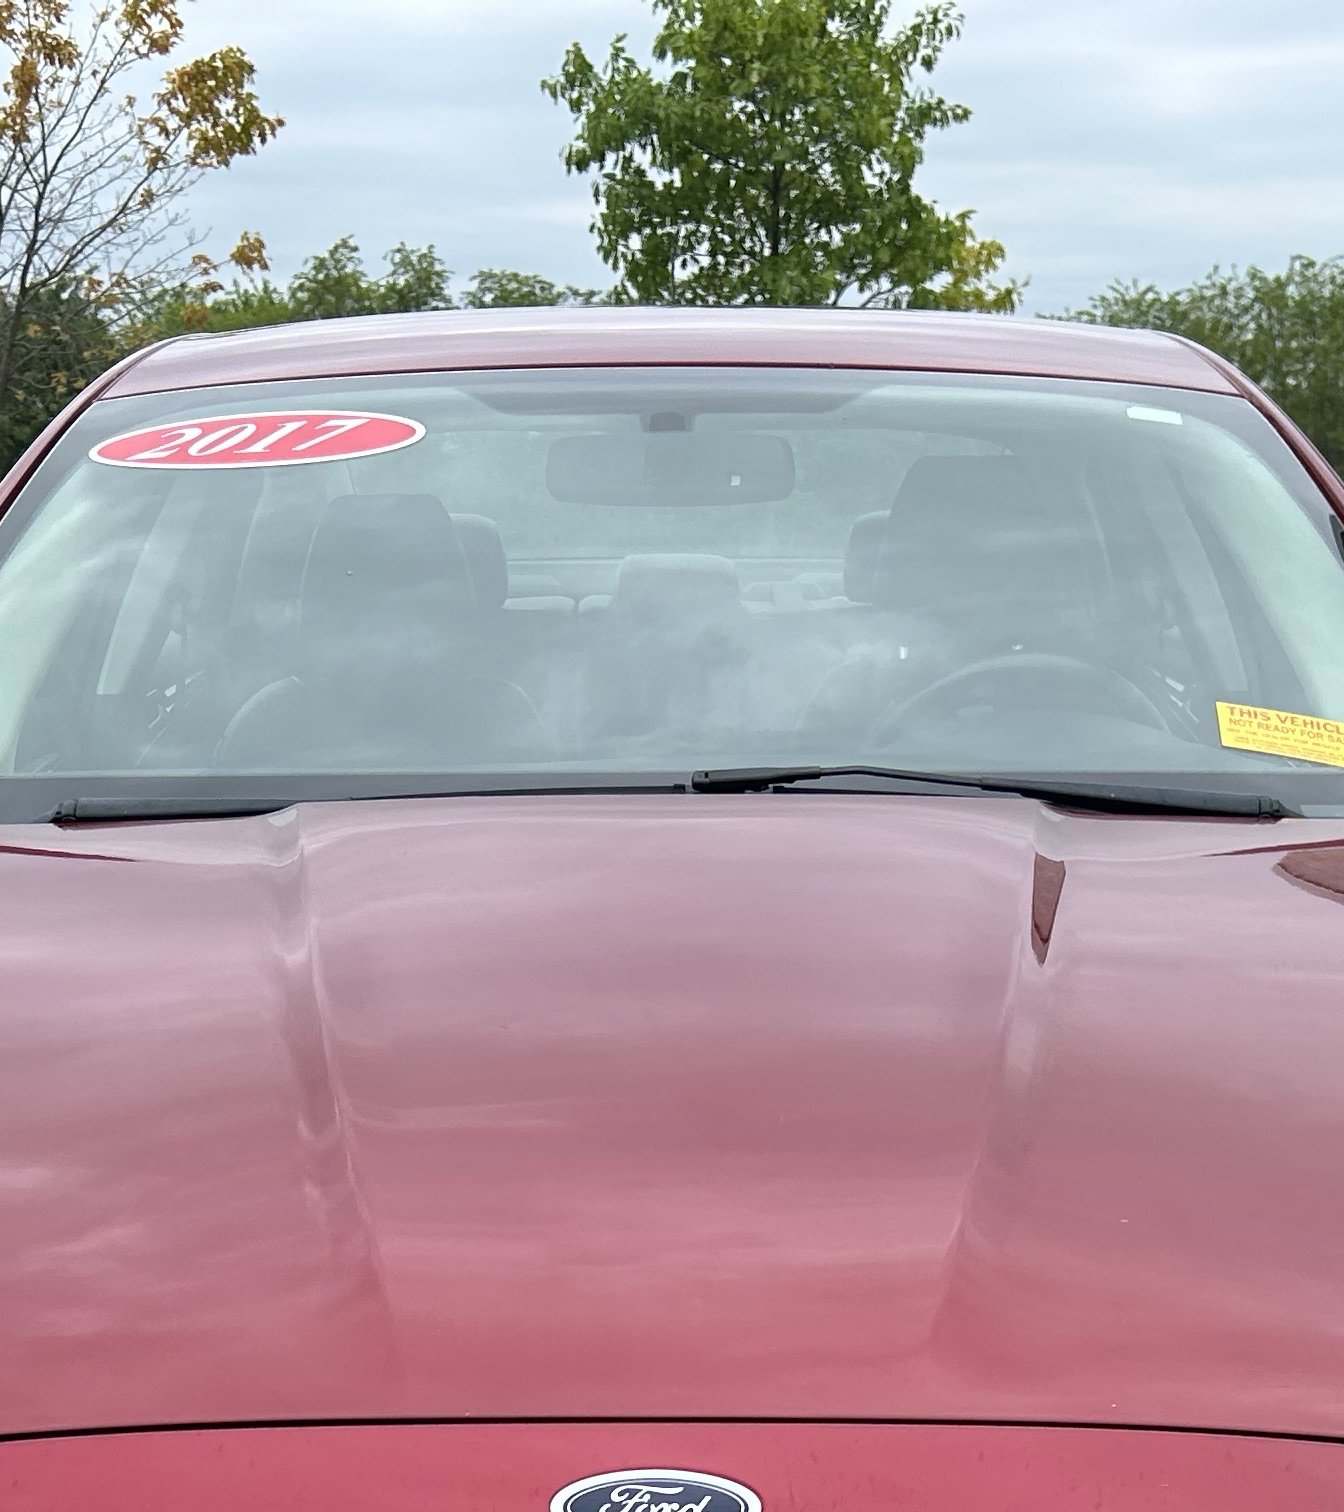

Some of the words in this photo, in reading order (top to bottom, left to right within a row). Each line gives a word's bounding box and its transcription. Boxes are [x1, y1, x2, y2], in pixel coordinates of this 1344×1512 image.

[123, 418, 371, 461] 2017
[1226, 706, 1271, 722] THIS
[1229, 718, 1254, 729] NOT
[1257, 722, 1296, 736] READY
[1300, 729, 1325, 741] FOR
